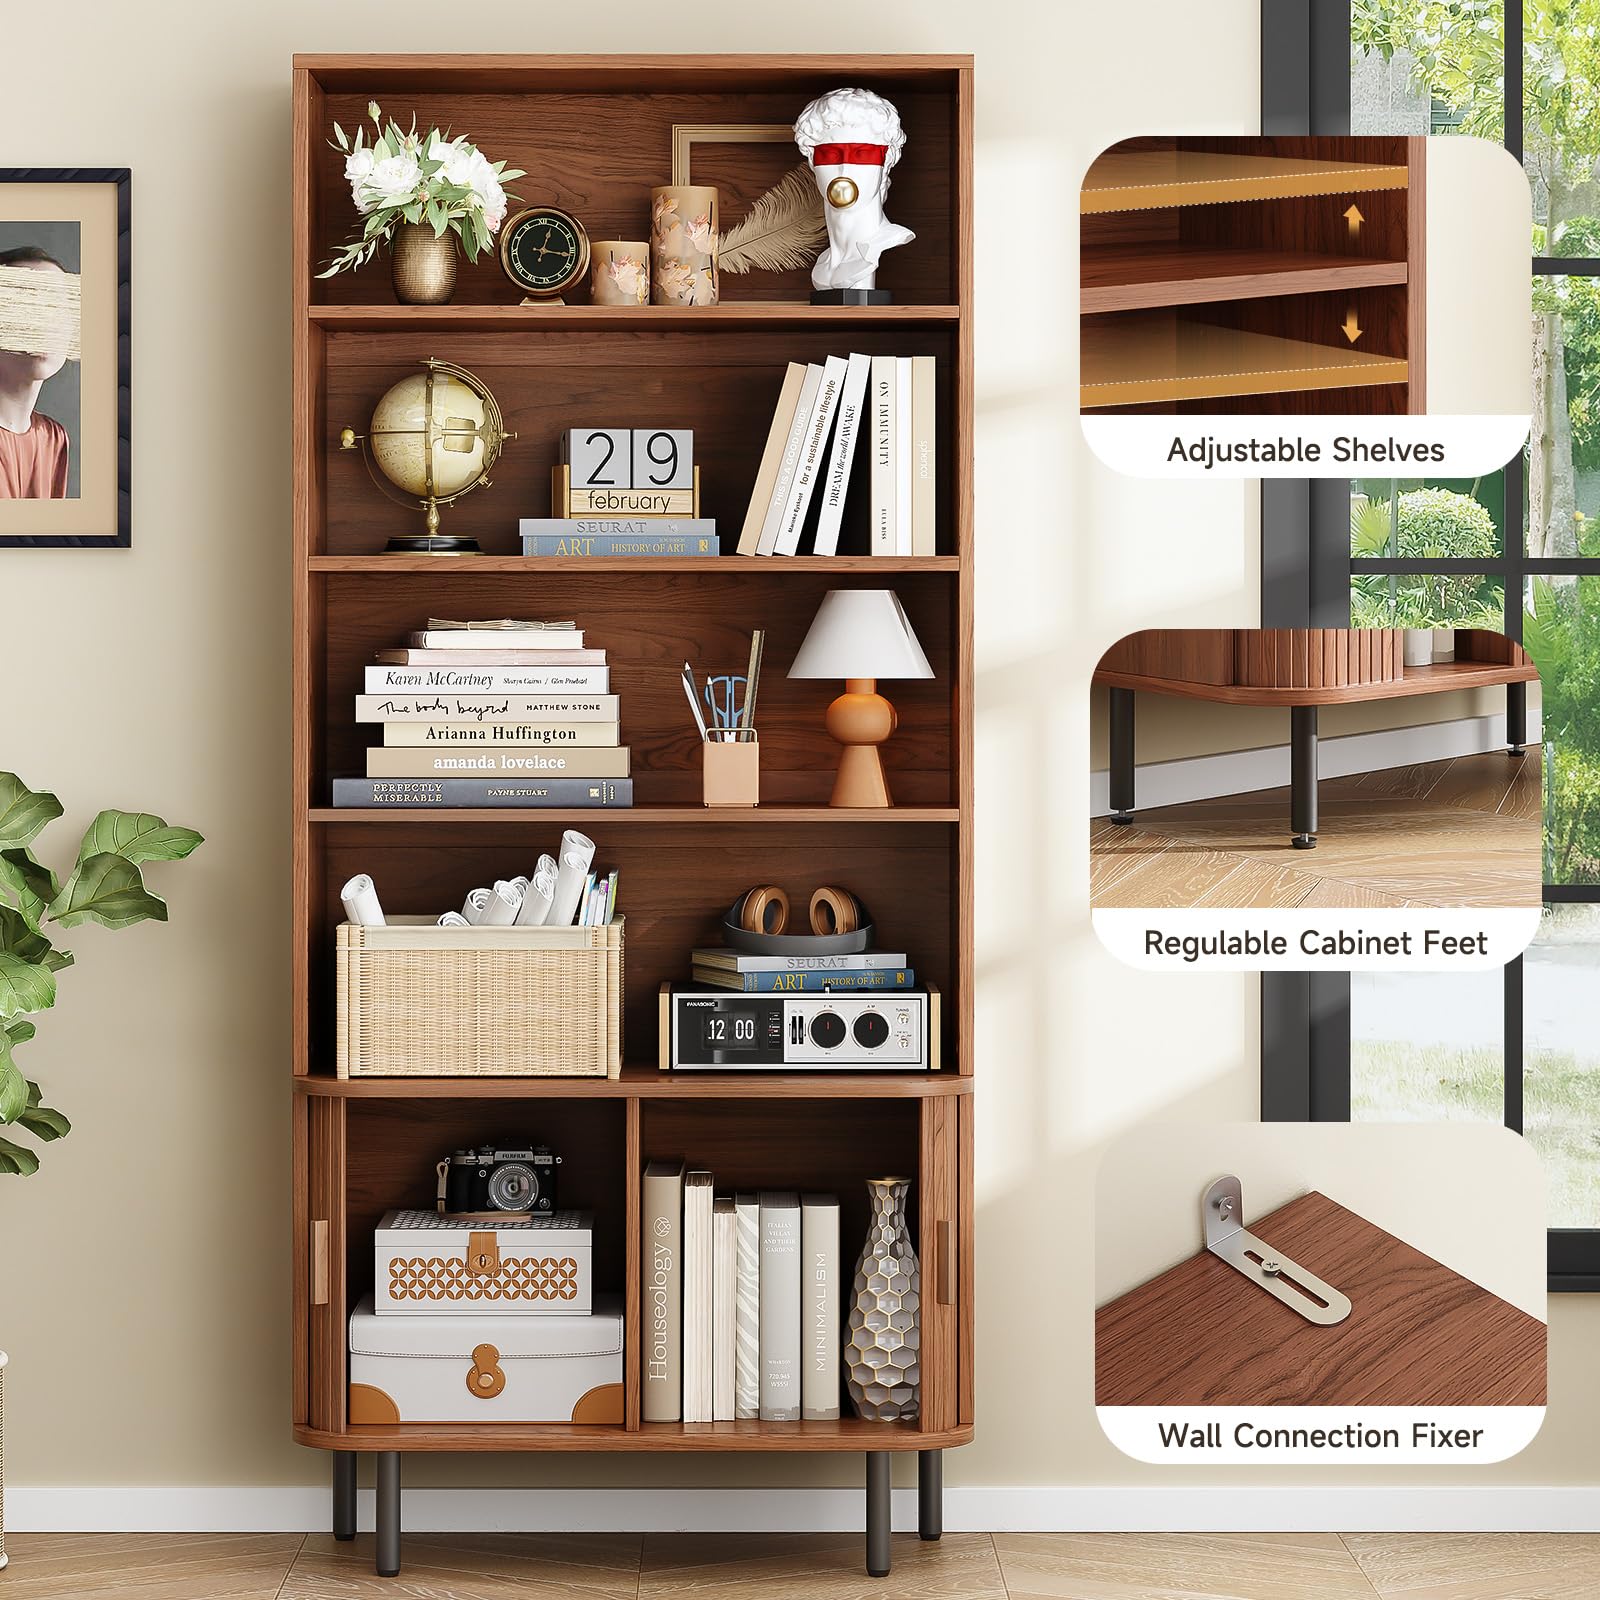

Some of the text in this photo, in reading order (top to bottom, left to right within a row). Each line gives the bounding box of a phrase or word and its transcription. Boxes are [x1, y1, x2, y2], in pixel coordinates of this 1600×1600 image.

[799, 472, 810, 486] for
[807, 414, 827, 464] sustainable
[819, 379, 836, 414] lifestyle
[879, 381, 889, 467] ON IMMUNITY
[585, 431, 679, 486] 2 9
[774, 407, 809, 506] THIS IS A GOOD GUIDE
[829, 404, 856, 507] DREAM the world AWAKE
[587, 490, 671, 513] february
[576, 521, 647, 533] SEURAT
[555, 538, 595, 556] ART
[611, 543, 685, 553] HISTORY OF ART
[385, 671, 494, 689] Karen McCartney
[377, 697, 509, 721] The body beyond
[425, 726, 577, 744] Arianna Huffington
[433, 755, 566, 769] amanda lovelace
[373, 783, 443, 792] PERFECTLY
[373, 793, 443, 802] MISERABLE
[787, 957, 848, 968] SEURAT
[772, 973, 808, 990] ART
[821, 976, 886, 986] HISTORY OF ART
[735, 1019, 754, 1040] 00
[648, 1242, 672, 1382] Houseology
[816, 1253, 826, 1371] MINIMALISM
